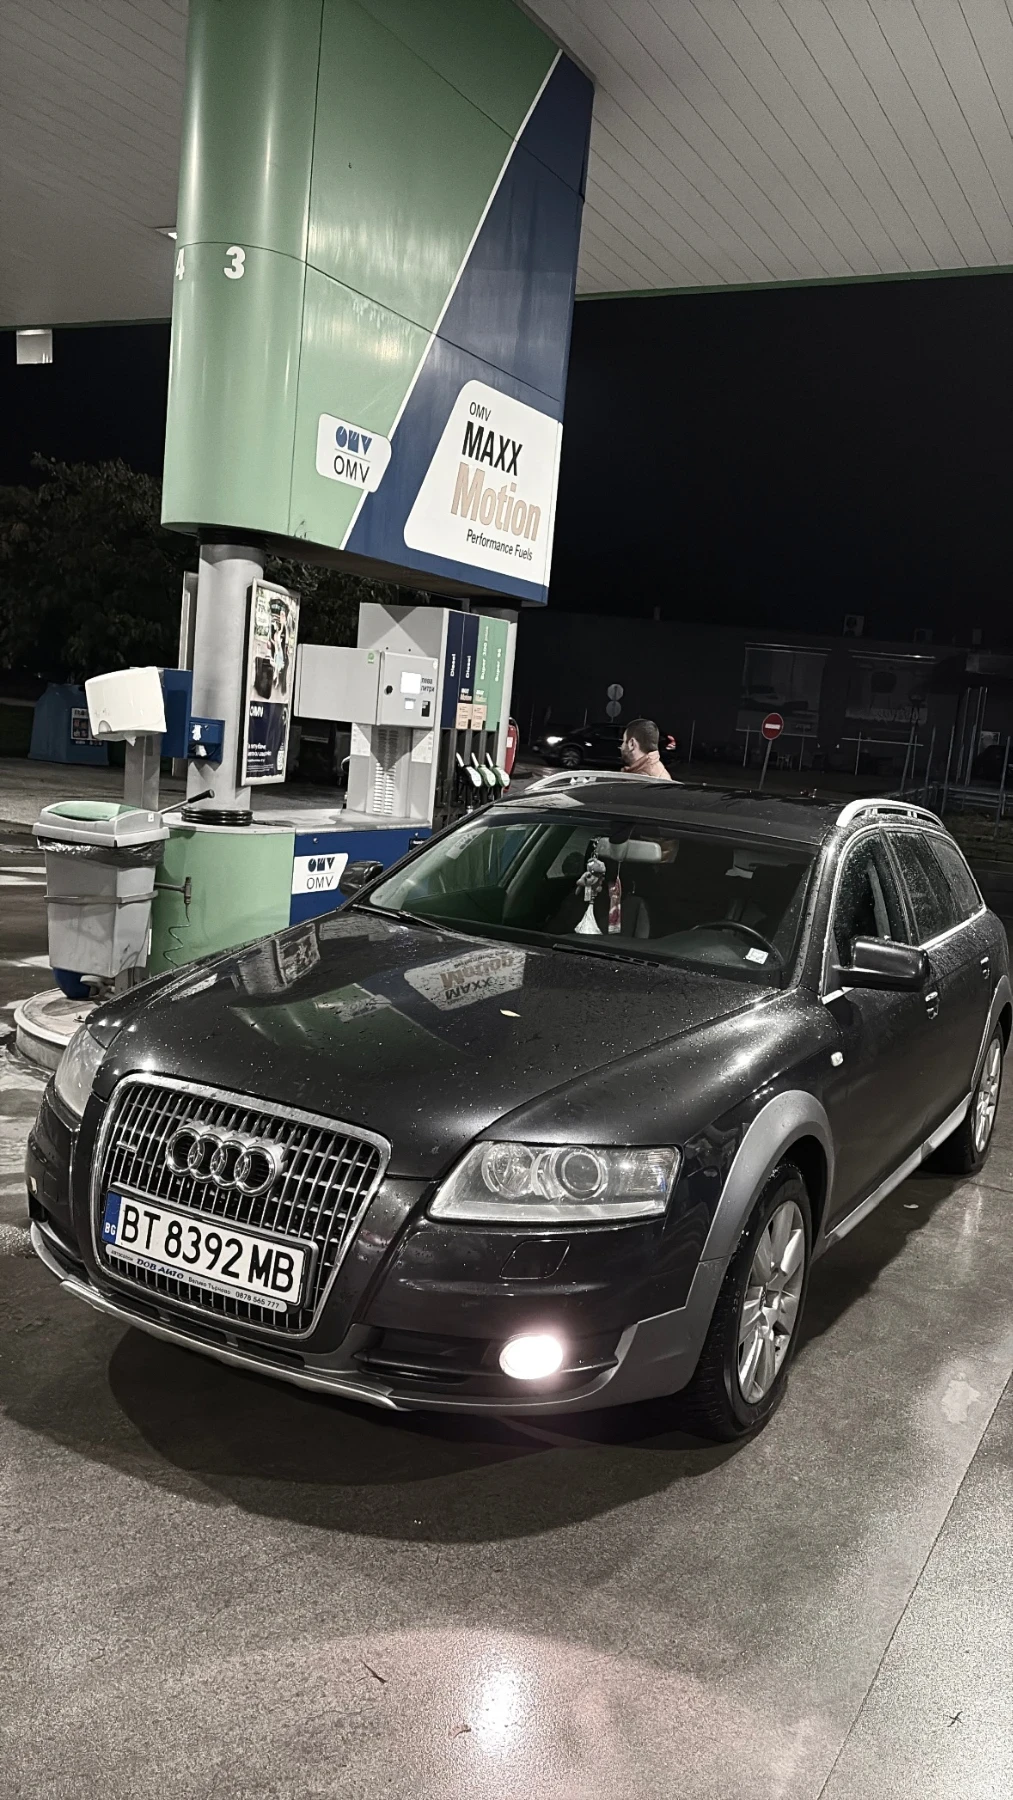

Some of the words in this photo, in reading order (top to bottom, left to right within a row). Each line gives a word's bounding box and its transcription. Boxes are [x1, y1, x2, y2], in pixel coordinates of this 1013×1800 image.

[176, 248, 184, 281] 4
[224, 246, 245, 279] 3
[469, 401, 491, 422] OMV
[461, 420, 523, 476] MAXX
[333, 455, 370, 483] OMV
[450, 461, 542, 542] Motion
[466, 528, 513, 555] Performance
[514, 543, 533, 561] Fuels
[306, 875, 334, 890] OMV
[104, 1222, 116, 1235] BG
[121, 1204, 161, 1250] BT
[164, 1220, 243, 1280] 8392
[247, 1244, 295, 1293] MB
[235, 1291, 252, 1301] 0878
[253, 1296, 266, 1305] 565
[267, 1300, 280, 1309] 777
